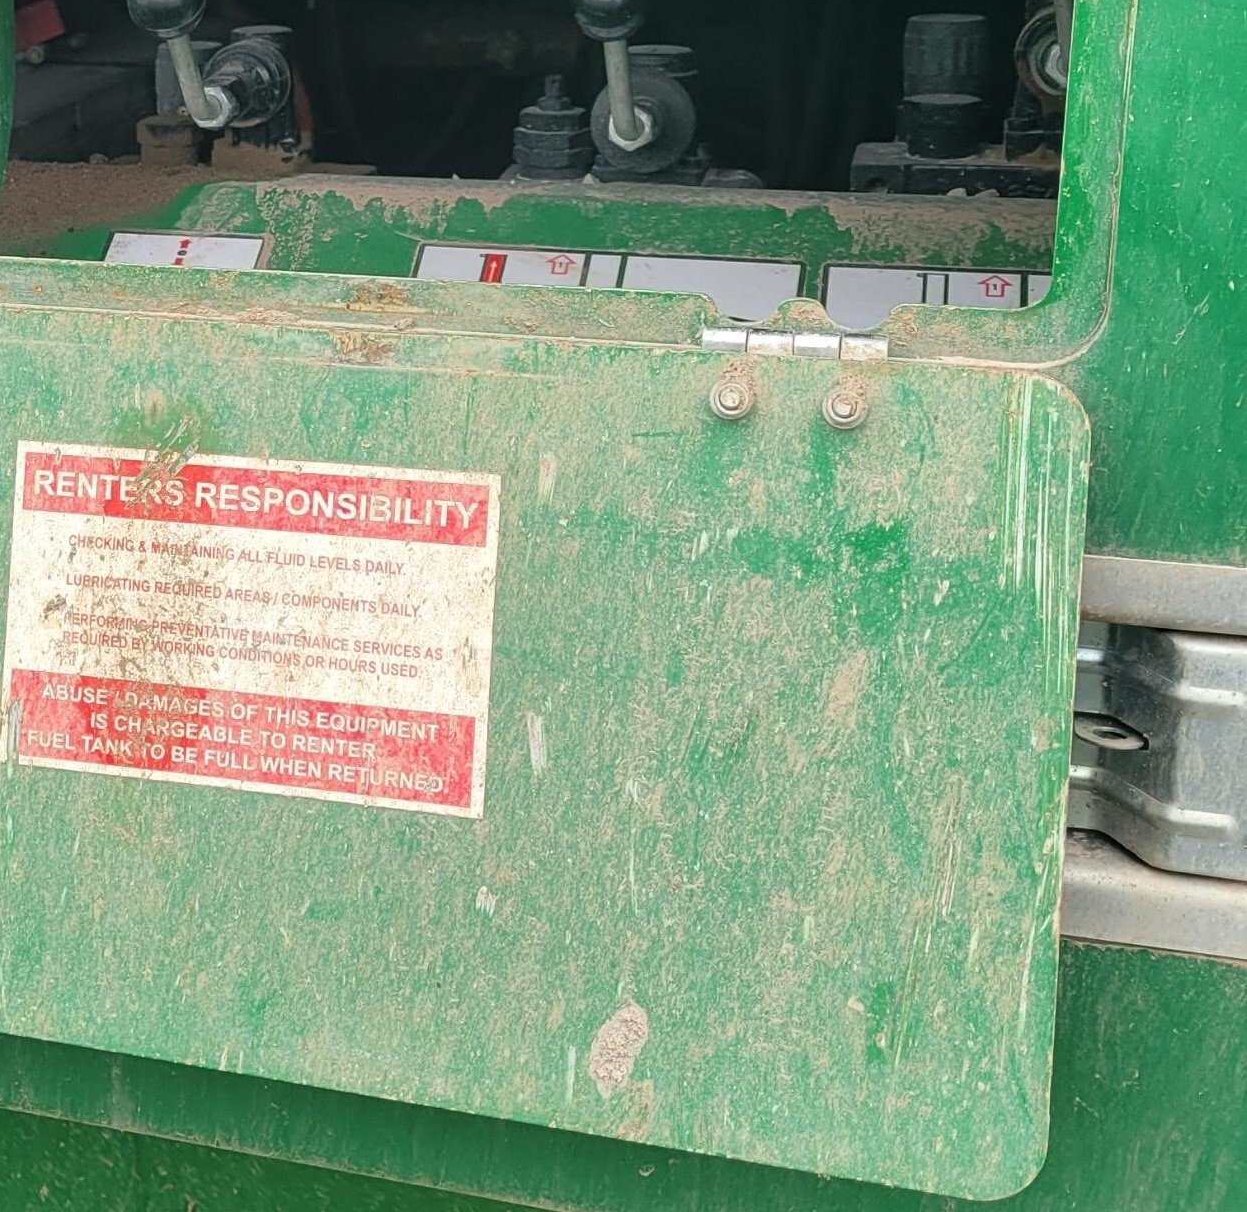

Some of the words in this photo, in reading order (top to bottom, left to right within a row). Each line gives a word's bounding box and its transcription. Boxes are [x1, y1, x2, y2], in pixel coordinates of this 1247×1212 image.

[33, 469, 184, 507] RENTERS
[194, 481, 478, 529] RESPONSIBILITY
[69, 534, 135, 552] CHECKING
[138, 540, 147, 553] &
[151, 541, 235, 560] MAINTAINING
[238, 549, 263, 563] ALL
[267, 551, 305, 567] FLUID
[310, 555, 361, 572] LEVELS
[366, 560, 406, 576] DAILY.
[66, 573, 151, 592] LUBRICATING
[154, 581, 222, 599] REQUIRED
[225, 589, 270, 605] AREAS
[282, 593, 377, 614] COMPONENTS
[381, 602, 422, 618] DAILY.
[62, 631, 127, 648] REQUIRED
[132, 638, 149, 651] BY
[153, 641, 215, 657] WORKING
[220, 646, 301, 666] CONDITIONS
[305, 654, 324, 668] OR
[329, 657, 377, 674] HOURS
[381, 662, 421, 679] USED.
[64, 612, 148, 630] PERFORMING
[152, 620, 248, 641] PREVENTATIVE
[253, 630, 349, 651] MAINTENANCE
[353, 640, 421, 659] SERVICES
[424, 647, 443, 661] AS
[42, 683, 108, 705] ABUSE
[124, 691, 225, 717] DAMAGES
[231, 703, 258, 721] OF
[264, 706, 310, 727] THIS
[316, 713, 440, 740] EQUIPMENT
[90, 712, 108, 730] IS
[114, 714, 252, 746] CHARGEABLE
[259, 731, 286, 749] TO
[28, 730, 76, 751] FUEL
[81, 735, 133, 757] TANK
[171, 745, 198, 764] BE
[204, 749, 254, 771] FULL
[260, 756, 322, 778] WHEN
